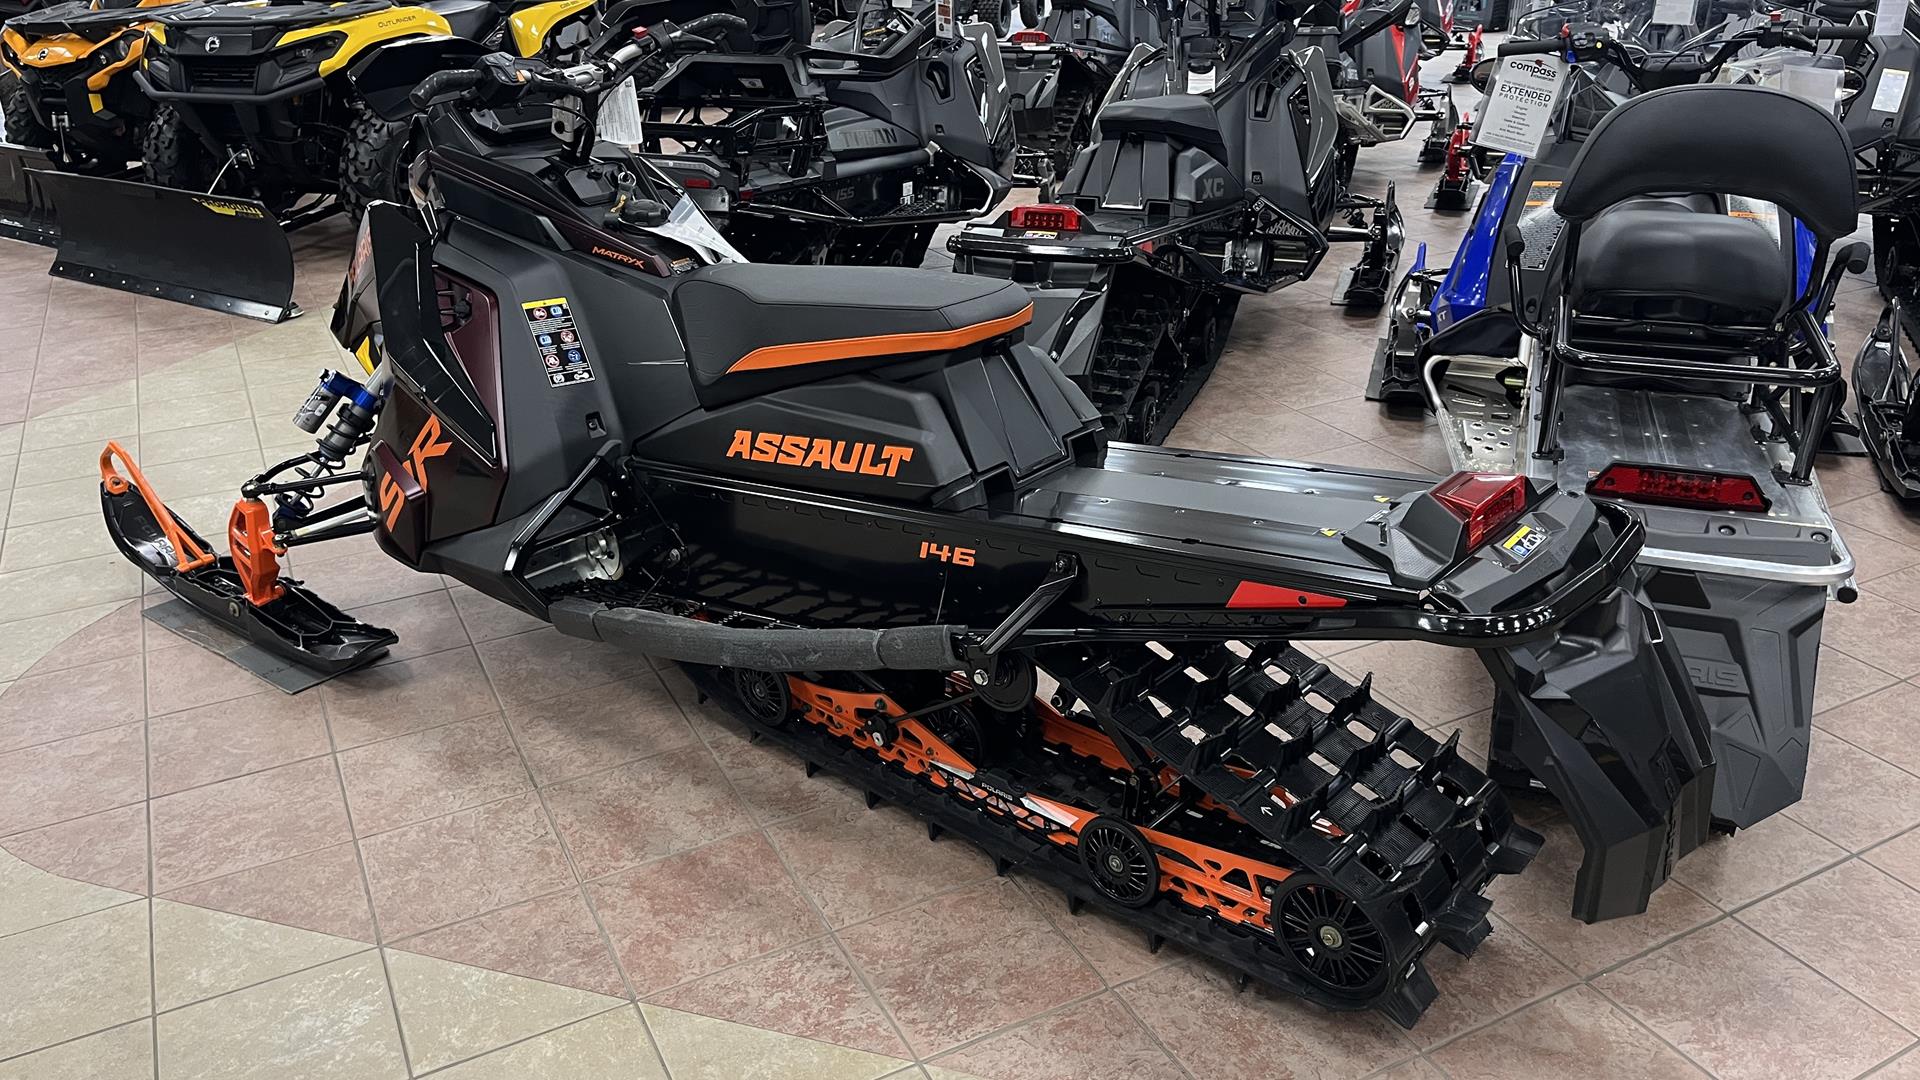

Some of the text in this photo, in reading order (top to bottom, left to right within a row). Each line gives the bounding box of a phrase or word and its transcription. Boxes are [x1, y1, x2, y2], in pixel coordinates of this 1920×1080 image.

[1510, 61, 1557, 77] compass
[1499, 92, 1548, 108] PROTECTION
[1500, 84, 1551, 102] EXTENDED
[836, 128, 898, 148] TITAN
[1202, 177, 1225, 200] XC
[592, 246, 645, 270] MATRYX
[726, 429, 913, 478] ASSAULT
[919, 541, 976, 567] 146
[981, 782, 1013, 801] POLARIS
